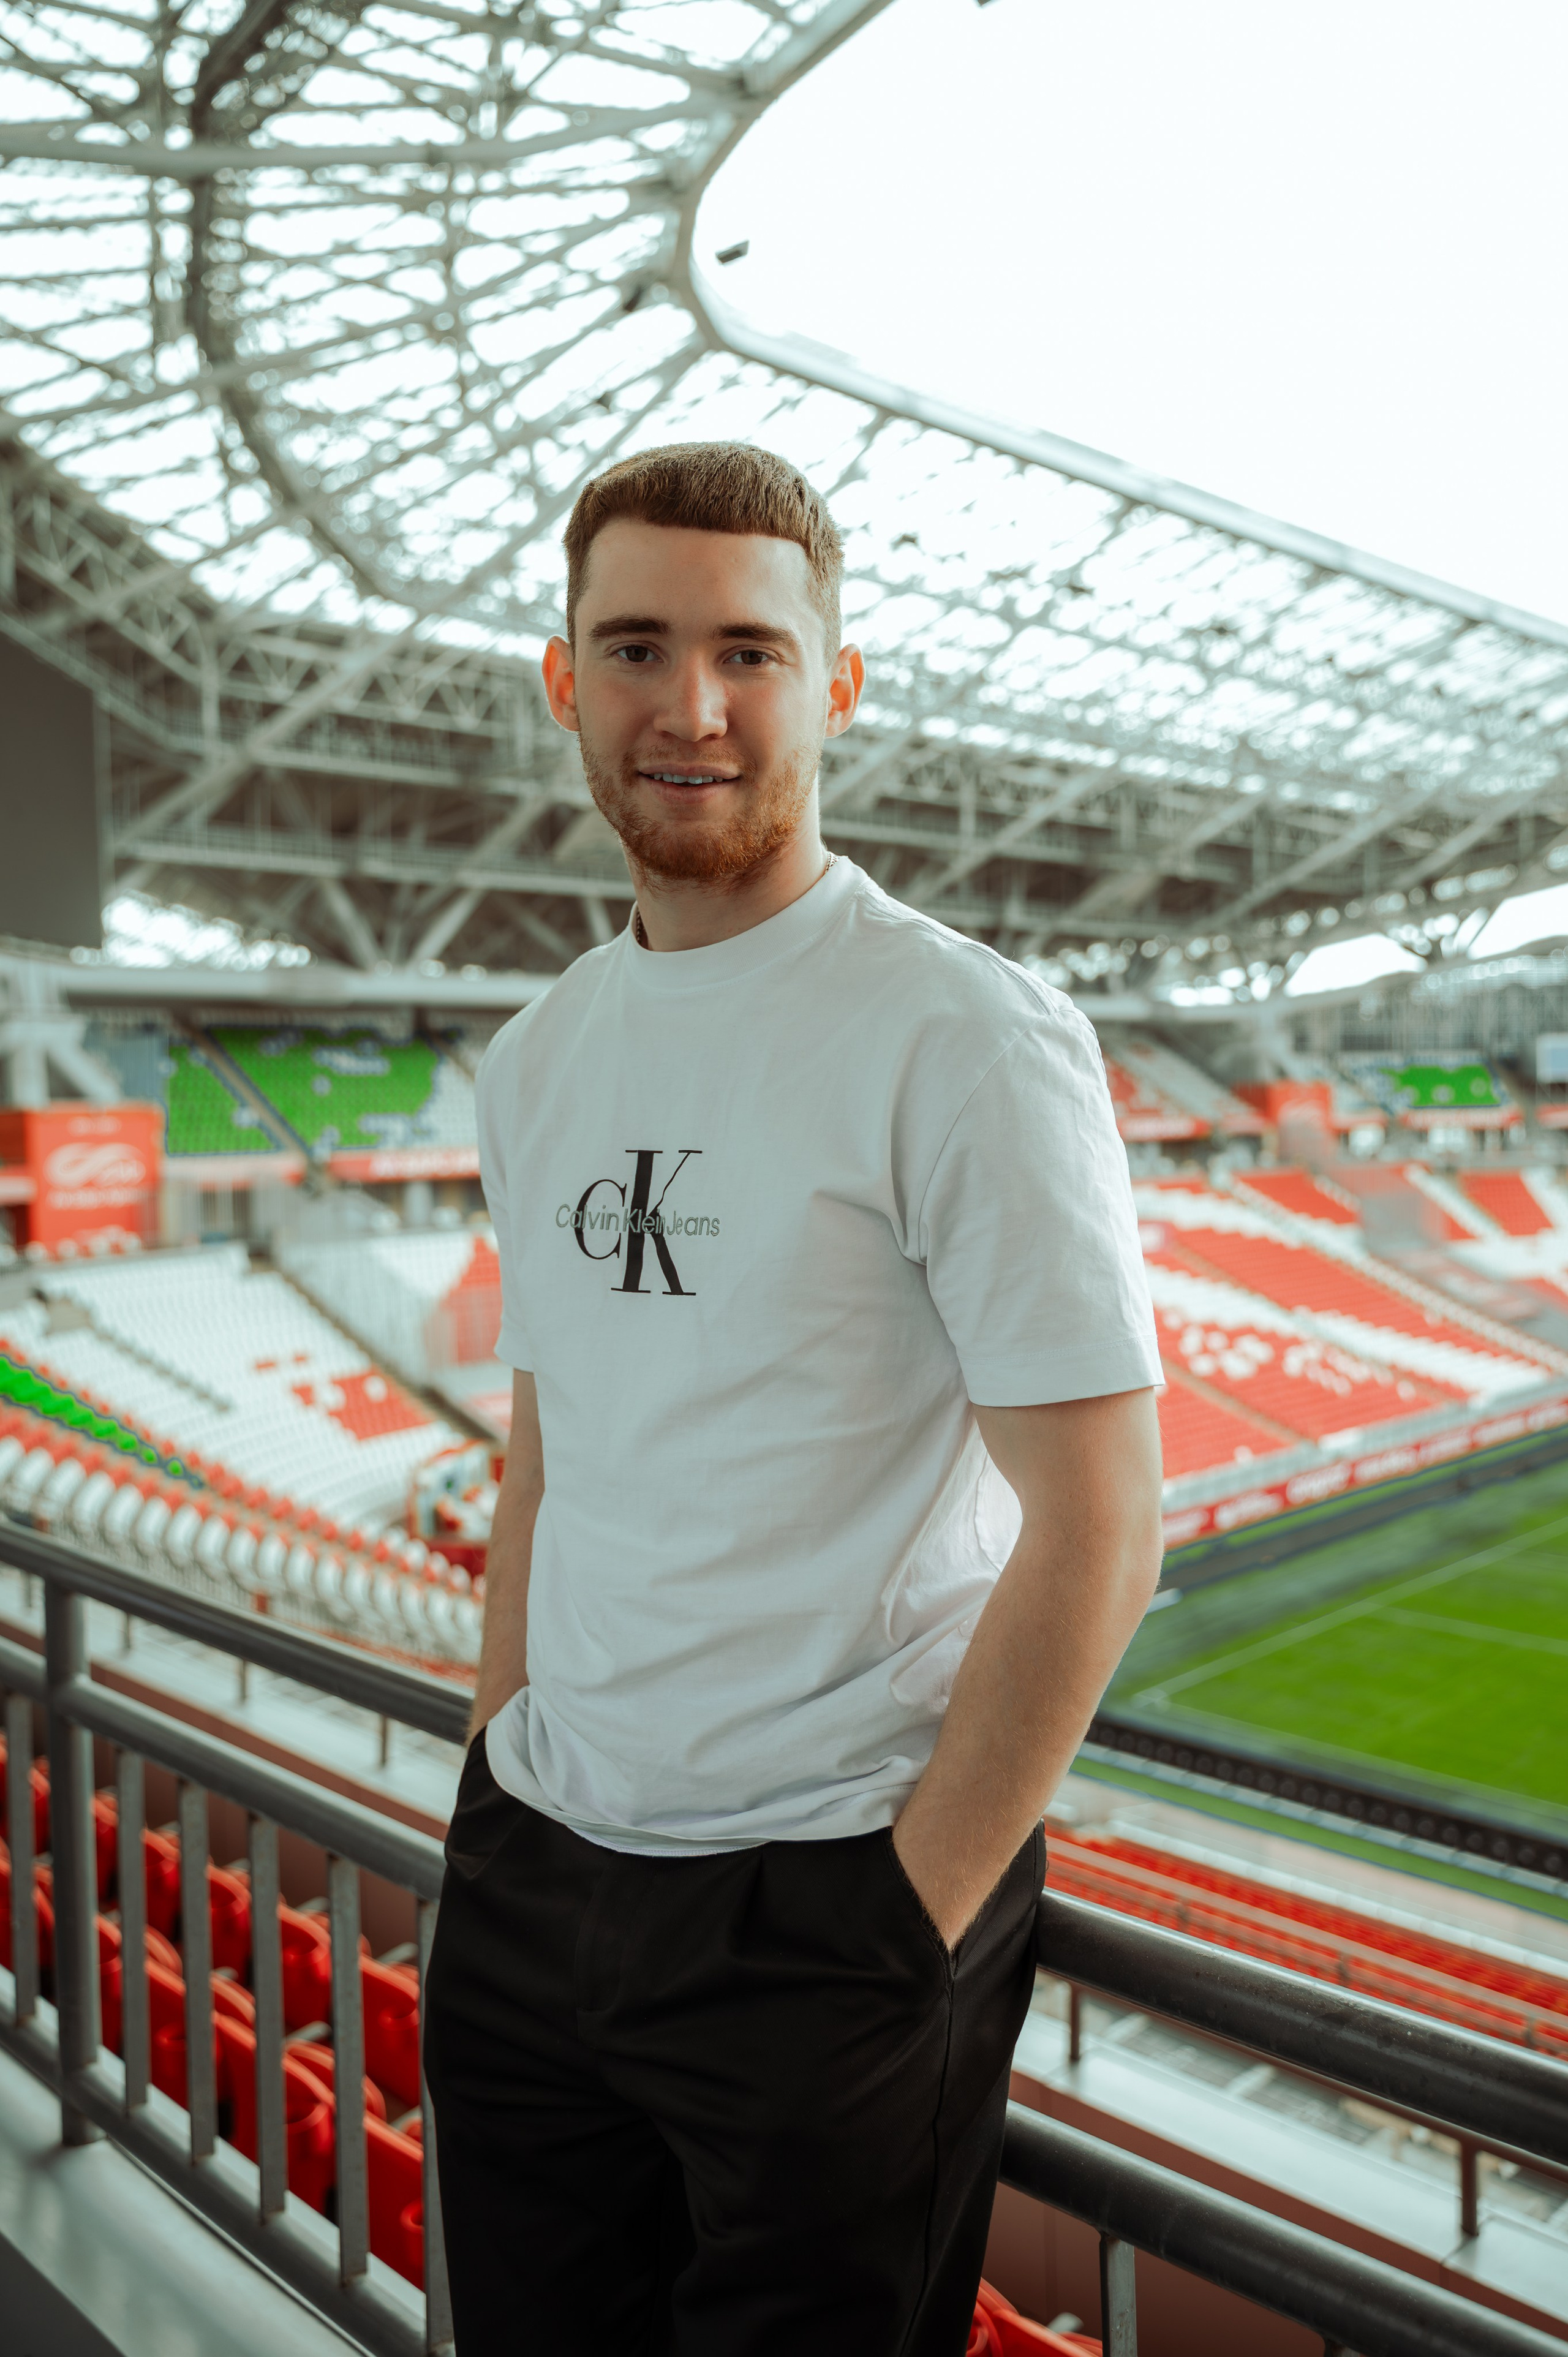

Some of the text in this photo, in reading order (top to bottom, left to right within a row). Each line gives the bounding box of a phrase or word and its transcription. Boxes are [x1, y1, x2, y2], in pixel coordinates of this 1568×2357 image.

[556, 1204, 720, 1237] Calvin Klein Jeans
